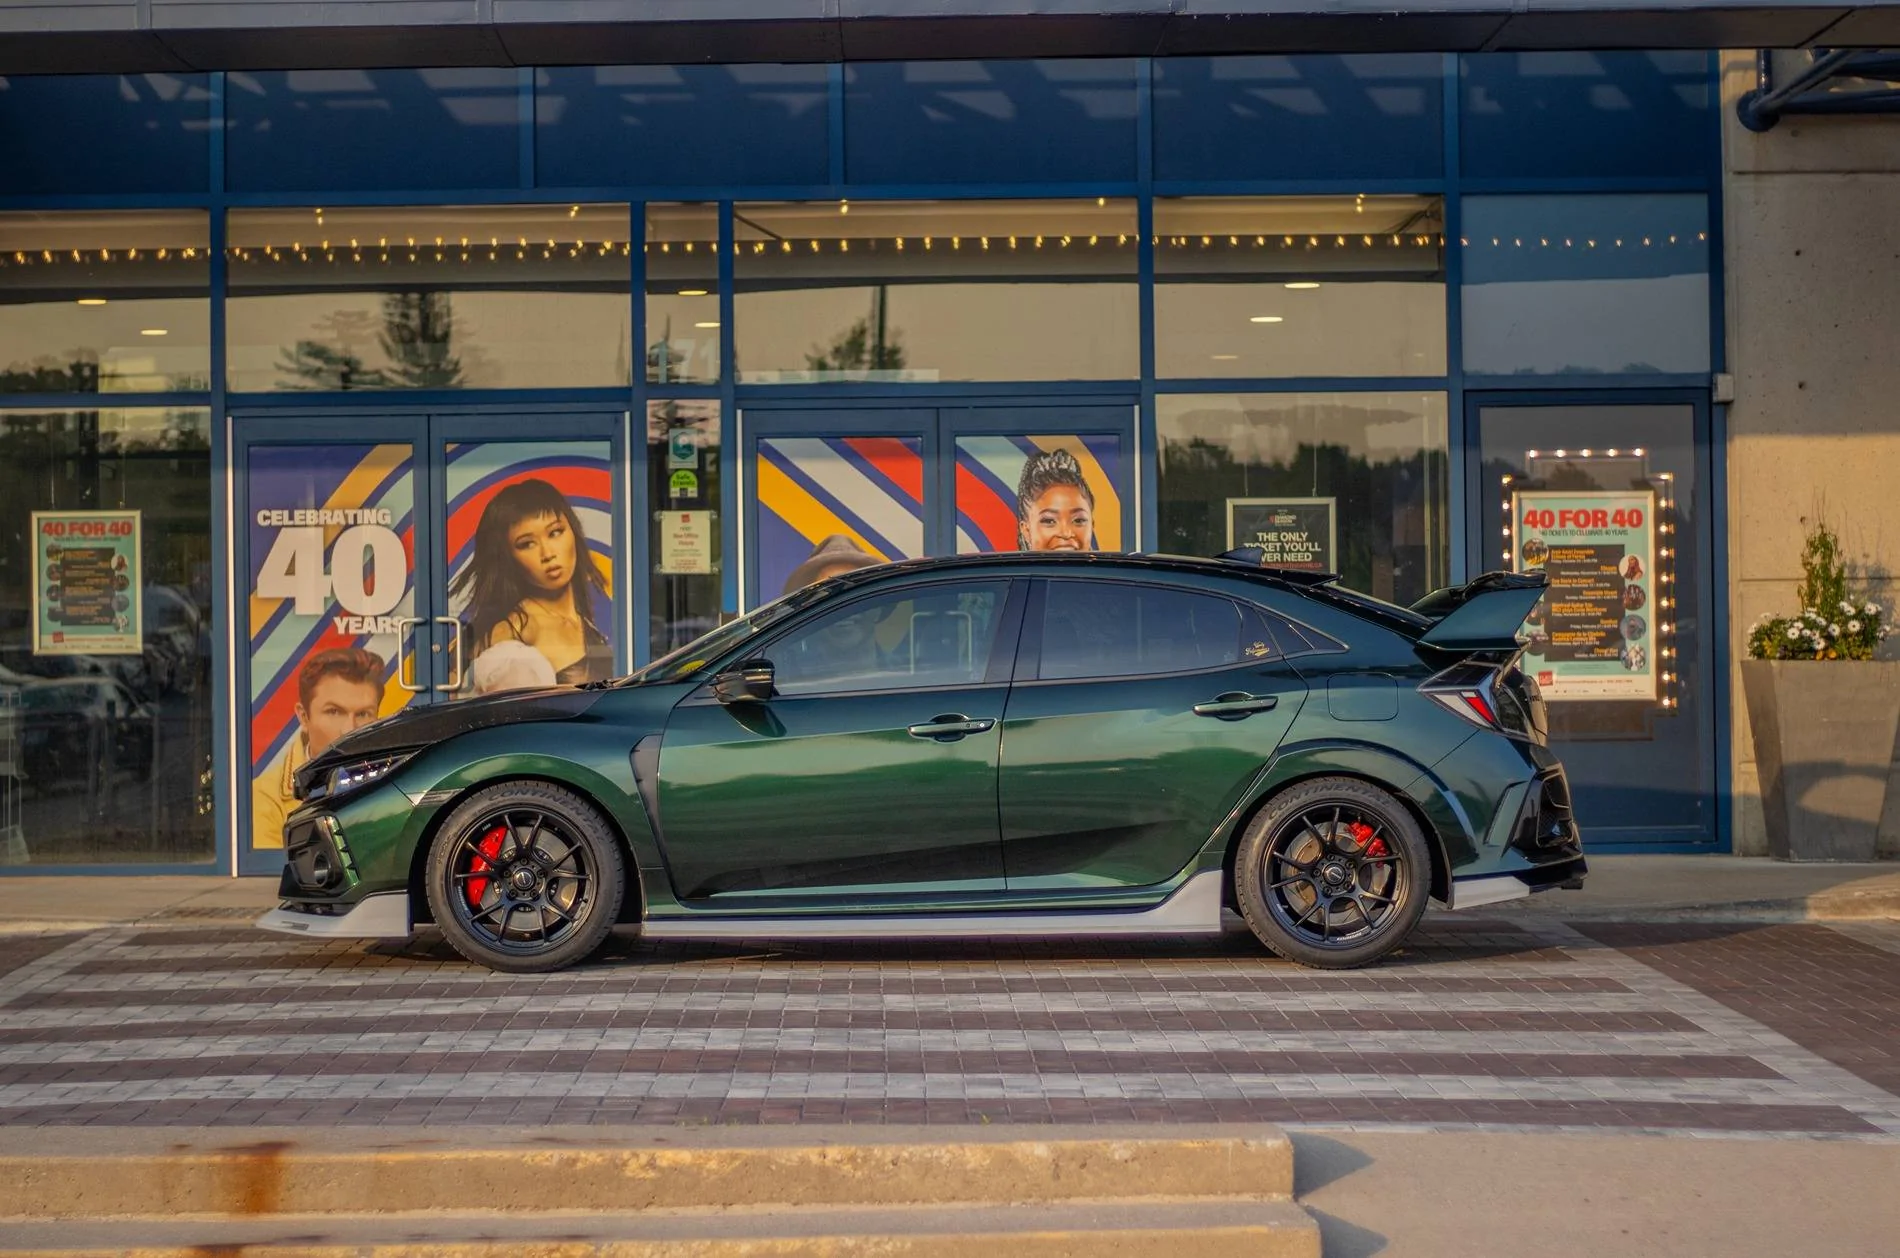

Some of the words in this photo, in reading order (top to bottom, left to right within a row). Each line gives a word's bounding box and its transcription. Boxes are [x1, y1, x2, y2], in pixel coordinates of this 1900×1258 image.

[257, 508, 391, 526] CELEBRATING
[1523, 509, 1555, 529] 40
[1559, 509, 1608, 529] FOR
[1611, 508, 1643, 528] 40
[42, 522, 65, 536] 40
[68, 522, 106, 537] FOR
[109, 521, 132, 536] 40
[1257, 532, 1278, 542] THE
[1280, 532, 1308, 542] ONLY
[1284, 542, 1321, 552] YOU'LL
[1261, 552, 1281, 562] VER
[1283, 552, 1312, 562] NEED
[257, 525, 407, 616] 40
[333, 616, 408, 635] YEARS
[1269, 783, 1389, 821] CONTINENTAL
[487, 788, 605, 843] CONTINENTAL
